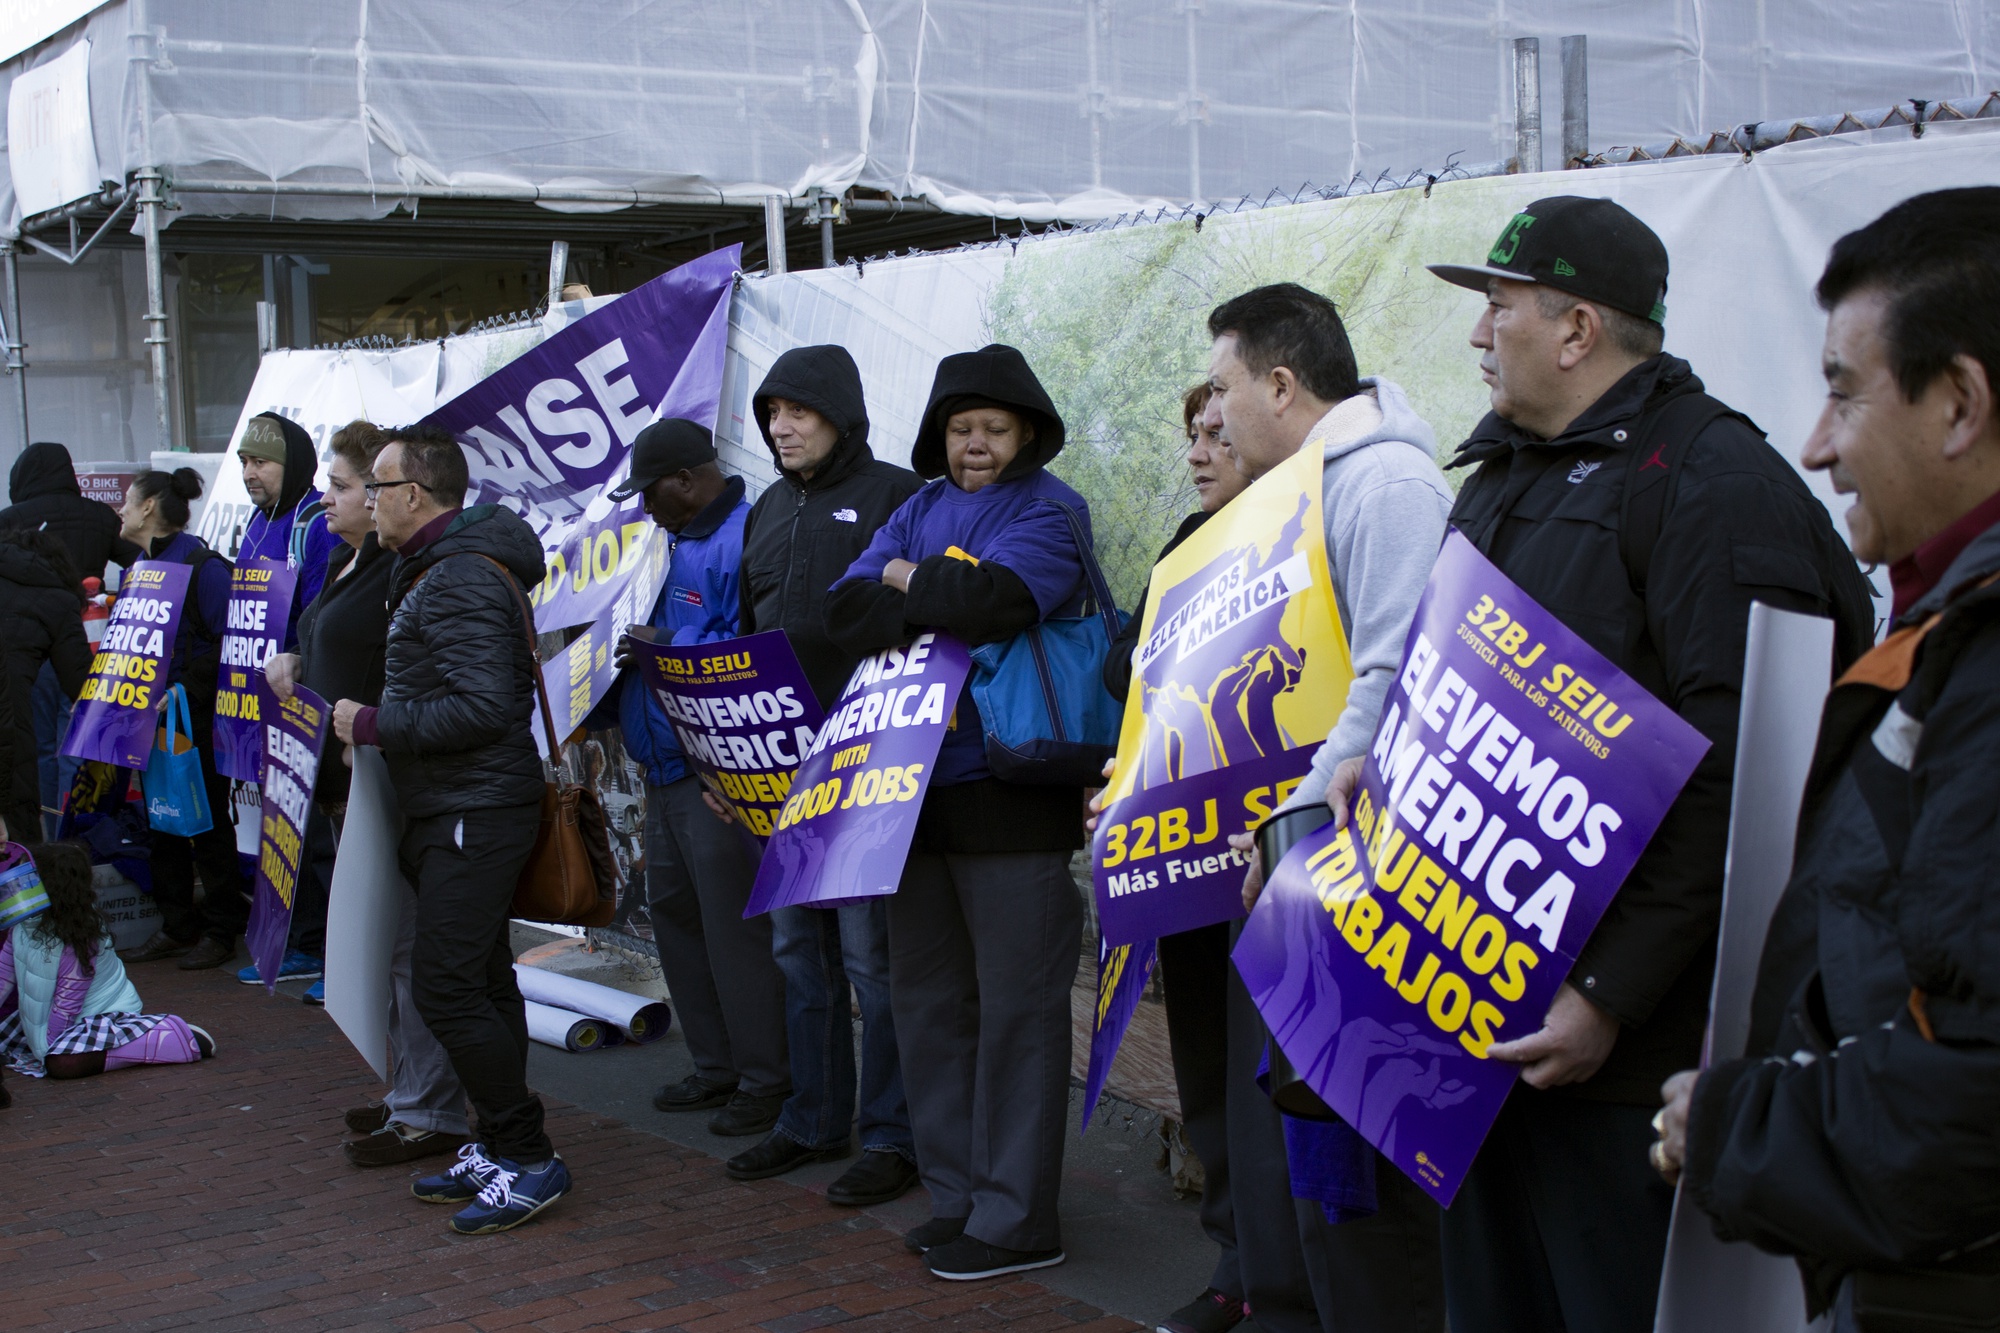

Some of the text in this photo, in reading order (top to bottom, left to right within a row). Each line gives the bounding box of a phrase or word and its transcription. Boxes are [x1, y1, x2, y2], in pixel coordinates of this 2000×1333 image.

[81, 491, 122, 501] ARKING
[93, 478, 119, 488] BIKE
[202, 501, 250, 557] OPE
[573, 521, 657, 593] JOB
[137, 570, 166, 582] SEIU
[245, 569, 272, 582] SEIU
[109, 597, 173, 624] EVEMOS
[674, 591, 701, 602] SUFFOLK
[1184, 571, 1289, 654] AMÉRICA
[227, 599, 268, 631] RAISE
[1141, 565, 1240, 663] #ELEVEMOS
[98, 620, 164, 657] ÉRICA
[220, 635, 278, 669] AMERICA
[88, 653, 158, 682] BUENOS
[655, 651, 752, 675] 32BJ SEIU
[717, 669, 758, 682] JANITORS
[841, 633, 936, 702] RAISE
[1466, 594, 1634, 738] 32BJ SEIU
[79, 678, 151, 709] ABAJOS
[231, 673, 247, 688] WITH
[569, 633, 591, 728] GOOD JOBS
[1456, 623, 1611, 760] JUSTICIA PARA LOS JANITORS
[216, 690, 261, 721] GOOD JOB
[656, 686, 805, 728] ELEVEMOS
[805, 683, 947, 762] AMERICA
[831, 743, 871, 772] WITH
[1400, 632, 1623, 868] ELEVEMOS
[716, 769, 800, 802] BUEN
[778, 763, 924, 831] GOOD JOBS
[1103, 798, 1219, 868] 32BJ
[1373, 701, 1576, 953] AMÉRICA
[261, 839, 294, 911] TRABAJOS
[1107, 868, 1159, 899] Más
[99, 896, 136, 910] UNITED
[1354, 788, 1539, 1002] CON BUENOS
[111, 911, 136, 922] STAL
[1305, 826, 1505, 1060] TRABAJOS
